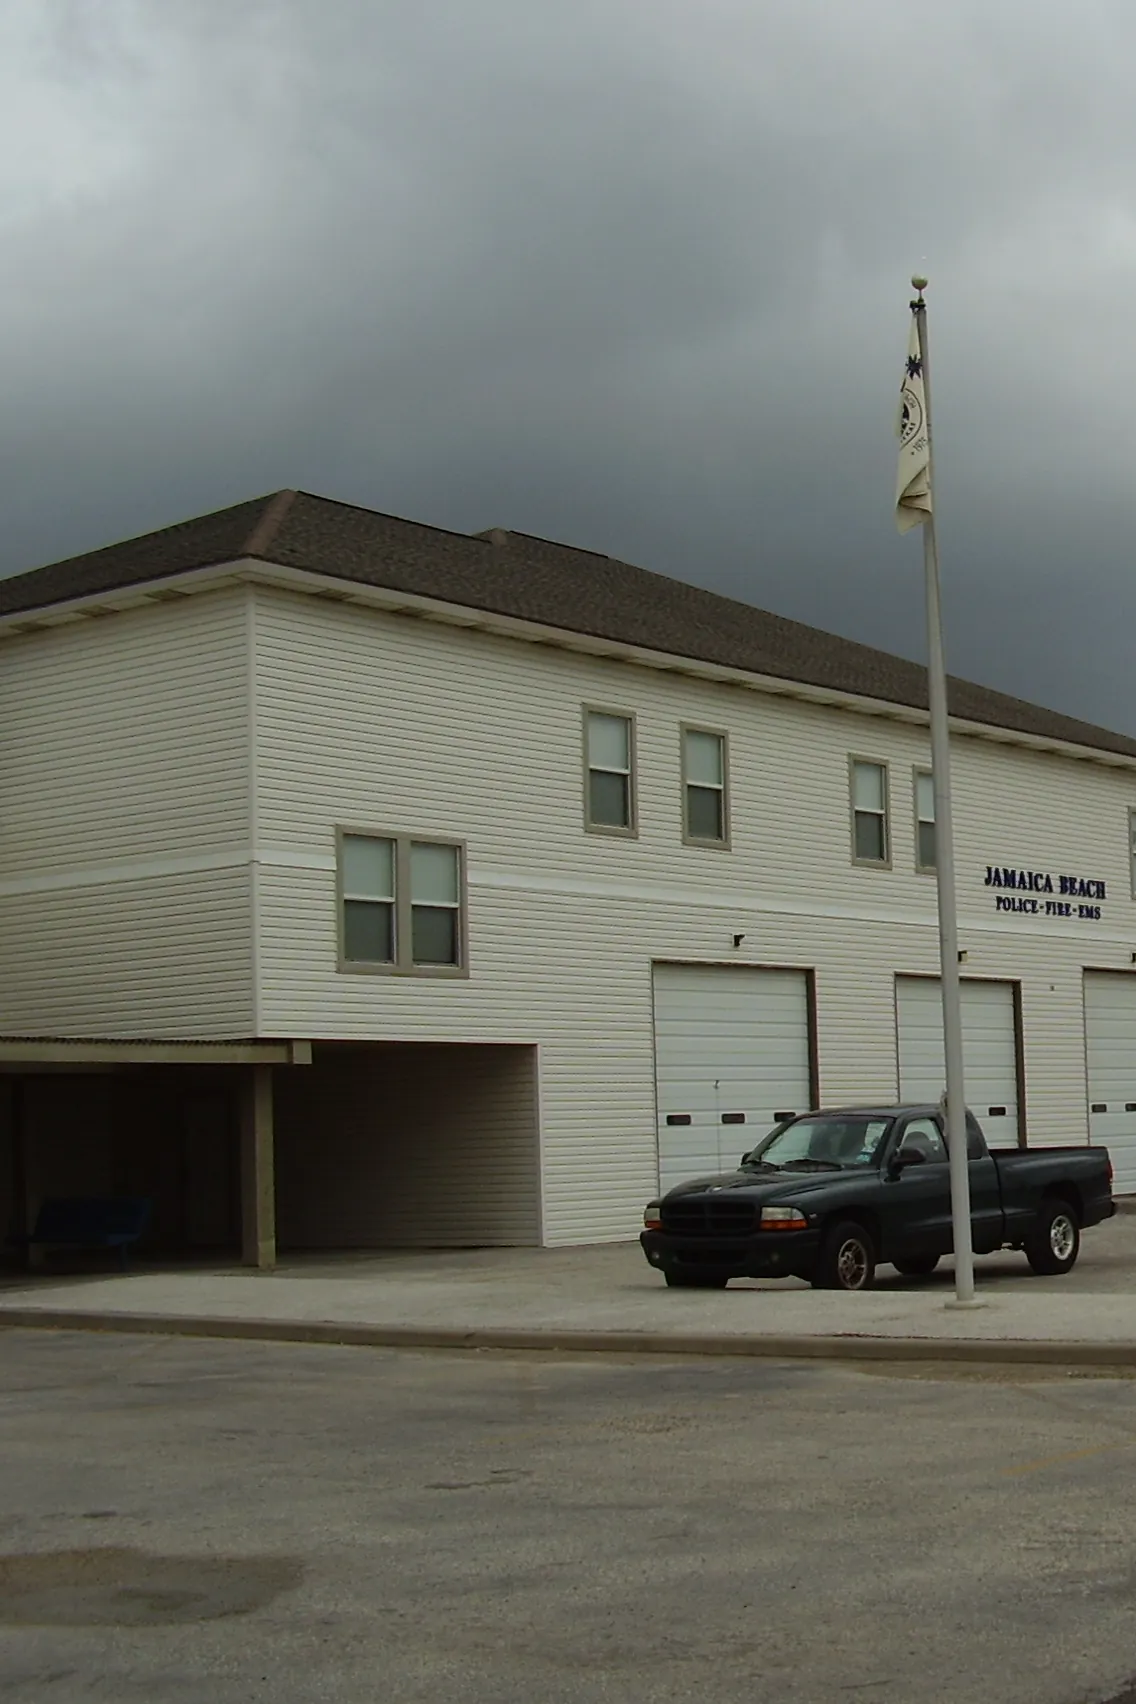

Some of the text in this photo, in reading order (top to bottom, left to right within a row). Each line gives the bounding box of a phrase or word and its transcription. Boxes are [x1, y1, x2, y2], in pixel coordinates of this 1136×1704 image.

[985, 866, 1106, 899] JAMAICA BEACH
[995, 895, 1102, 920] POLICE FIRE EMS
